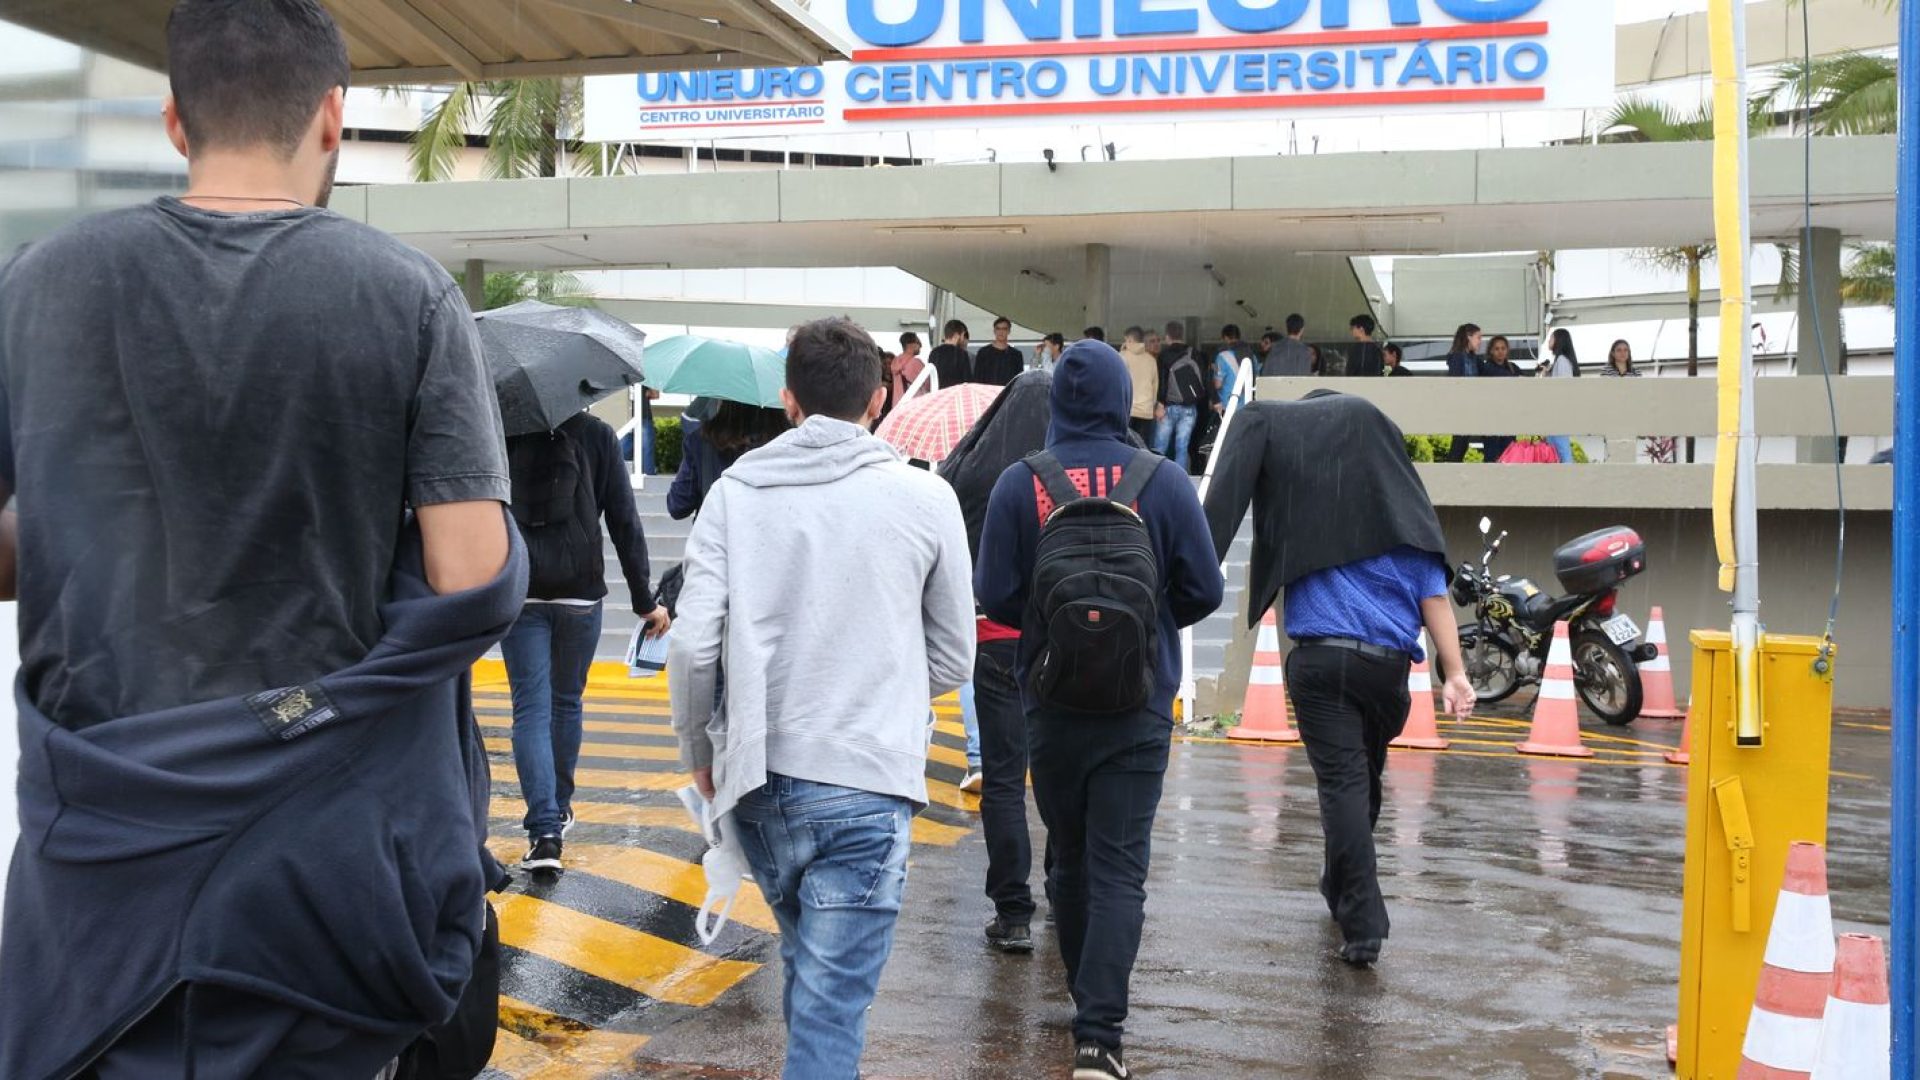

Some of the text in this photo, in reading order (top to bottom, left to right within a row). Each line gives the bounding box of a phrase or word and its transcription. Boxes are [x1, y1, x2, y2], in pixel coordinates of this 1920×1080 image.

[637, 66, 825, 102] UNIEURO
[845, 40, 1549, 102] CENTRO UNIVERSITÁRIO
[640, 106, 825, 124] CENTRO UNIVERSITÁRIO
